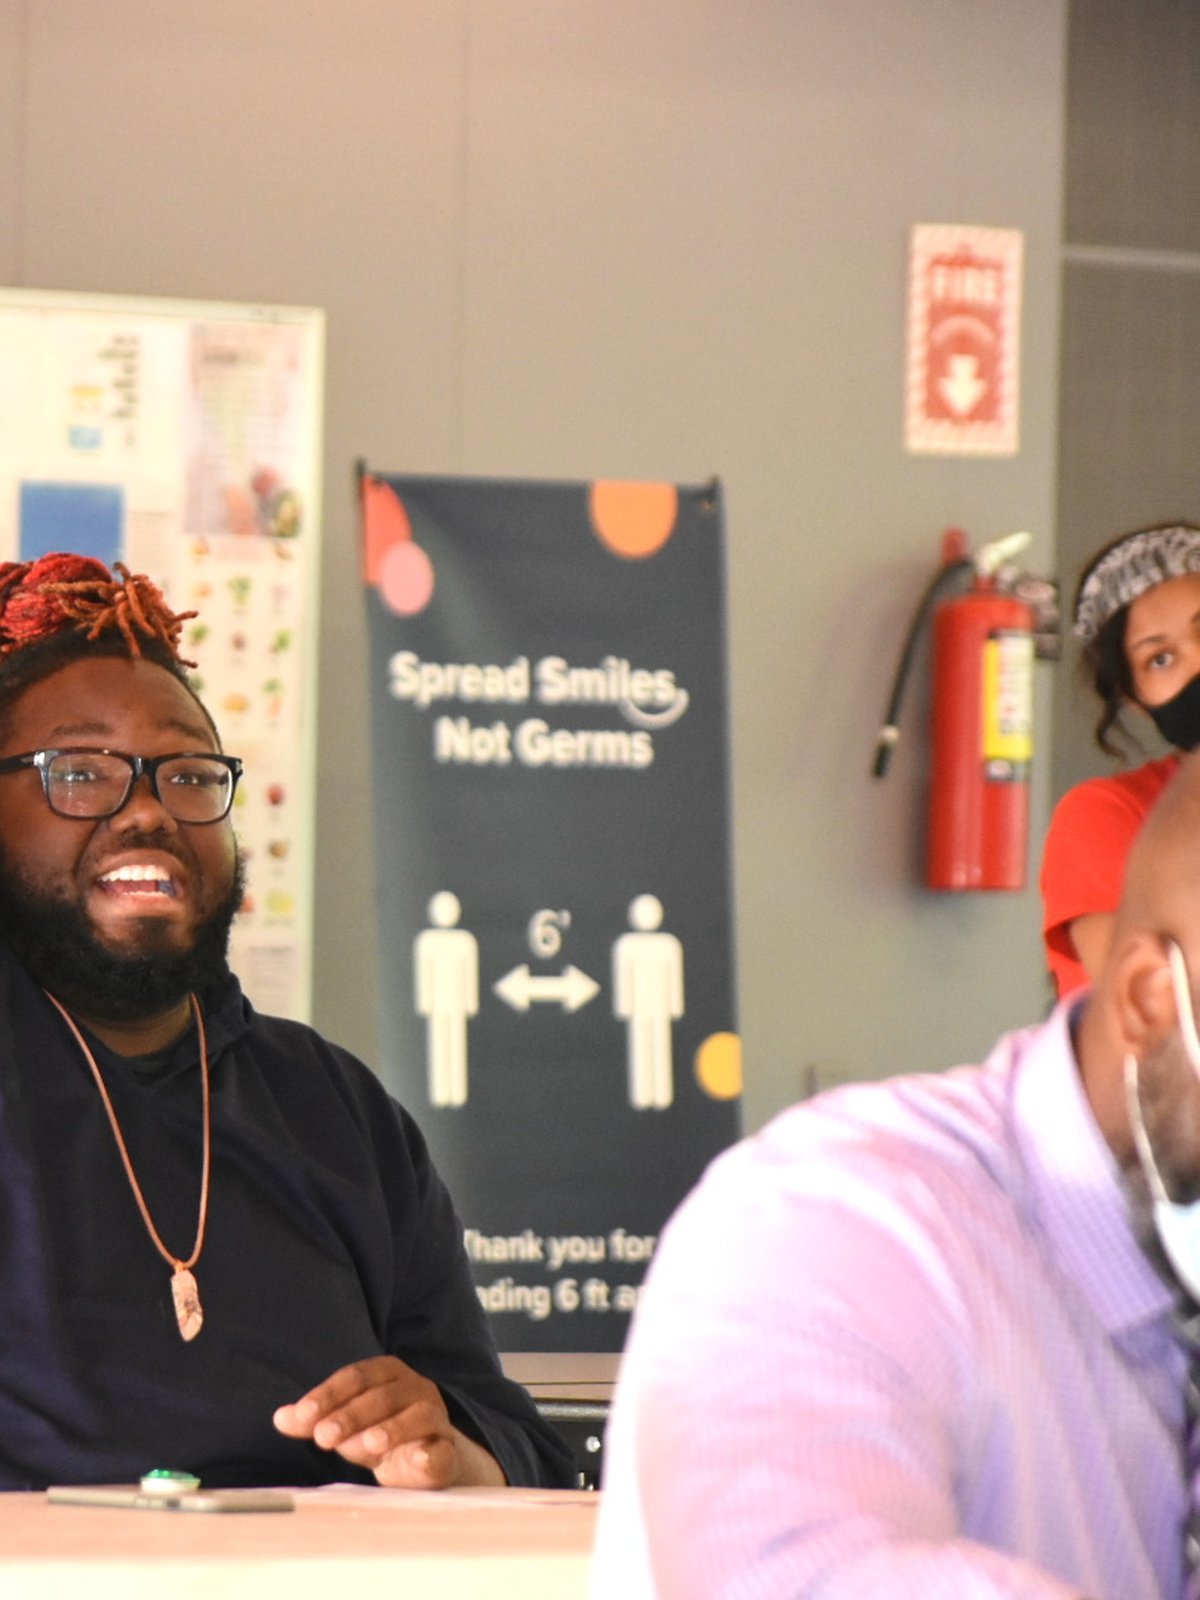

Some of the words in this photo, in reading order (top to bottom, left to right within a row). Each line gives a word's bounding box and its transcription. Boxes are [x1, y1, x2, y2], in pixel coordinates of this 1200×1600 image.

[388, 650, 531, 710] Spread
[535, 655, 677, 706] Smiles
[434, 715, 512, 766] Not
[514, 718, 655, 770] Germs
[546, 1235, 605, 1270] you
[609, 1228, 657, 1262] for
[554, 1278, 580, 1312] 6
[582, 1278, 610, 1312] ft
